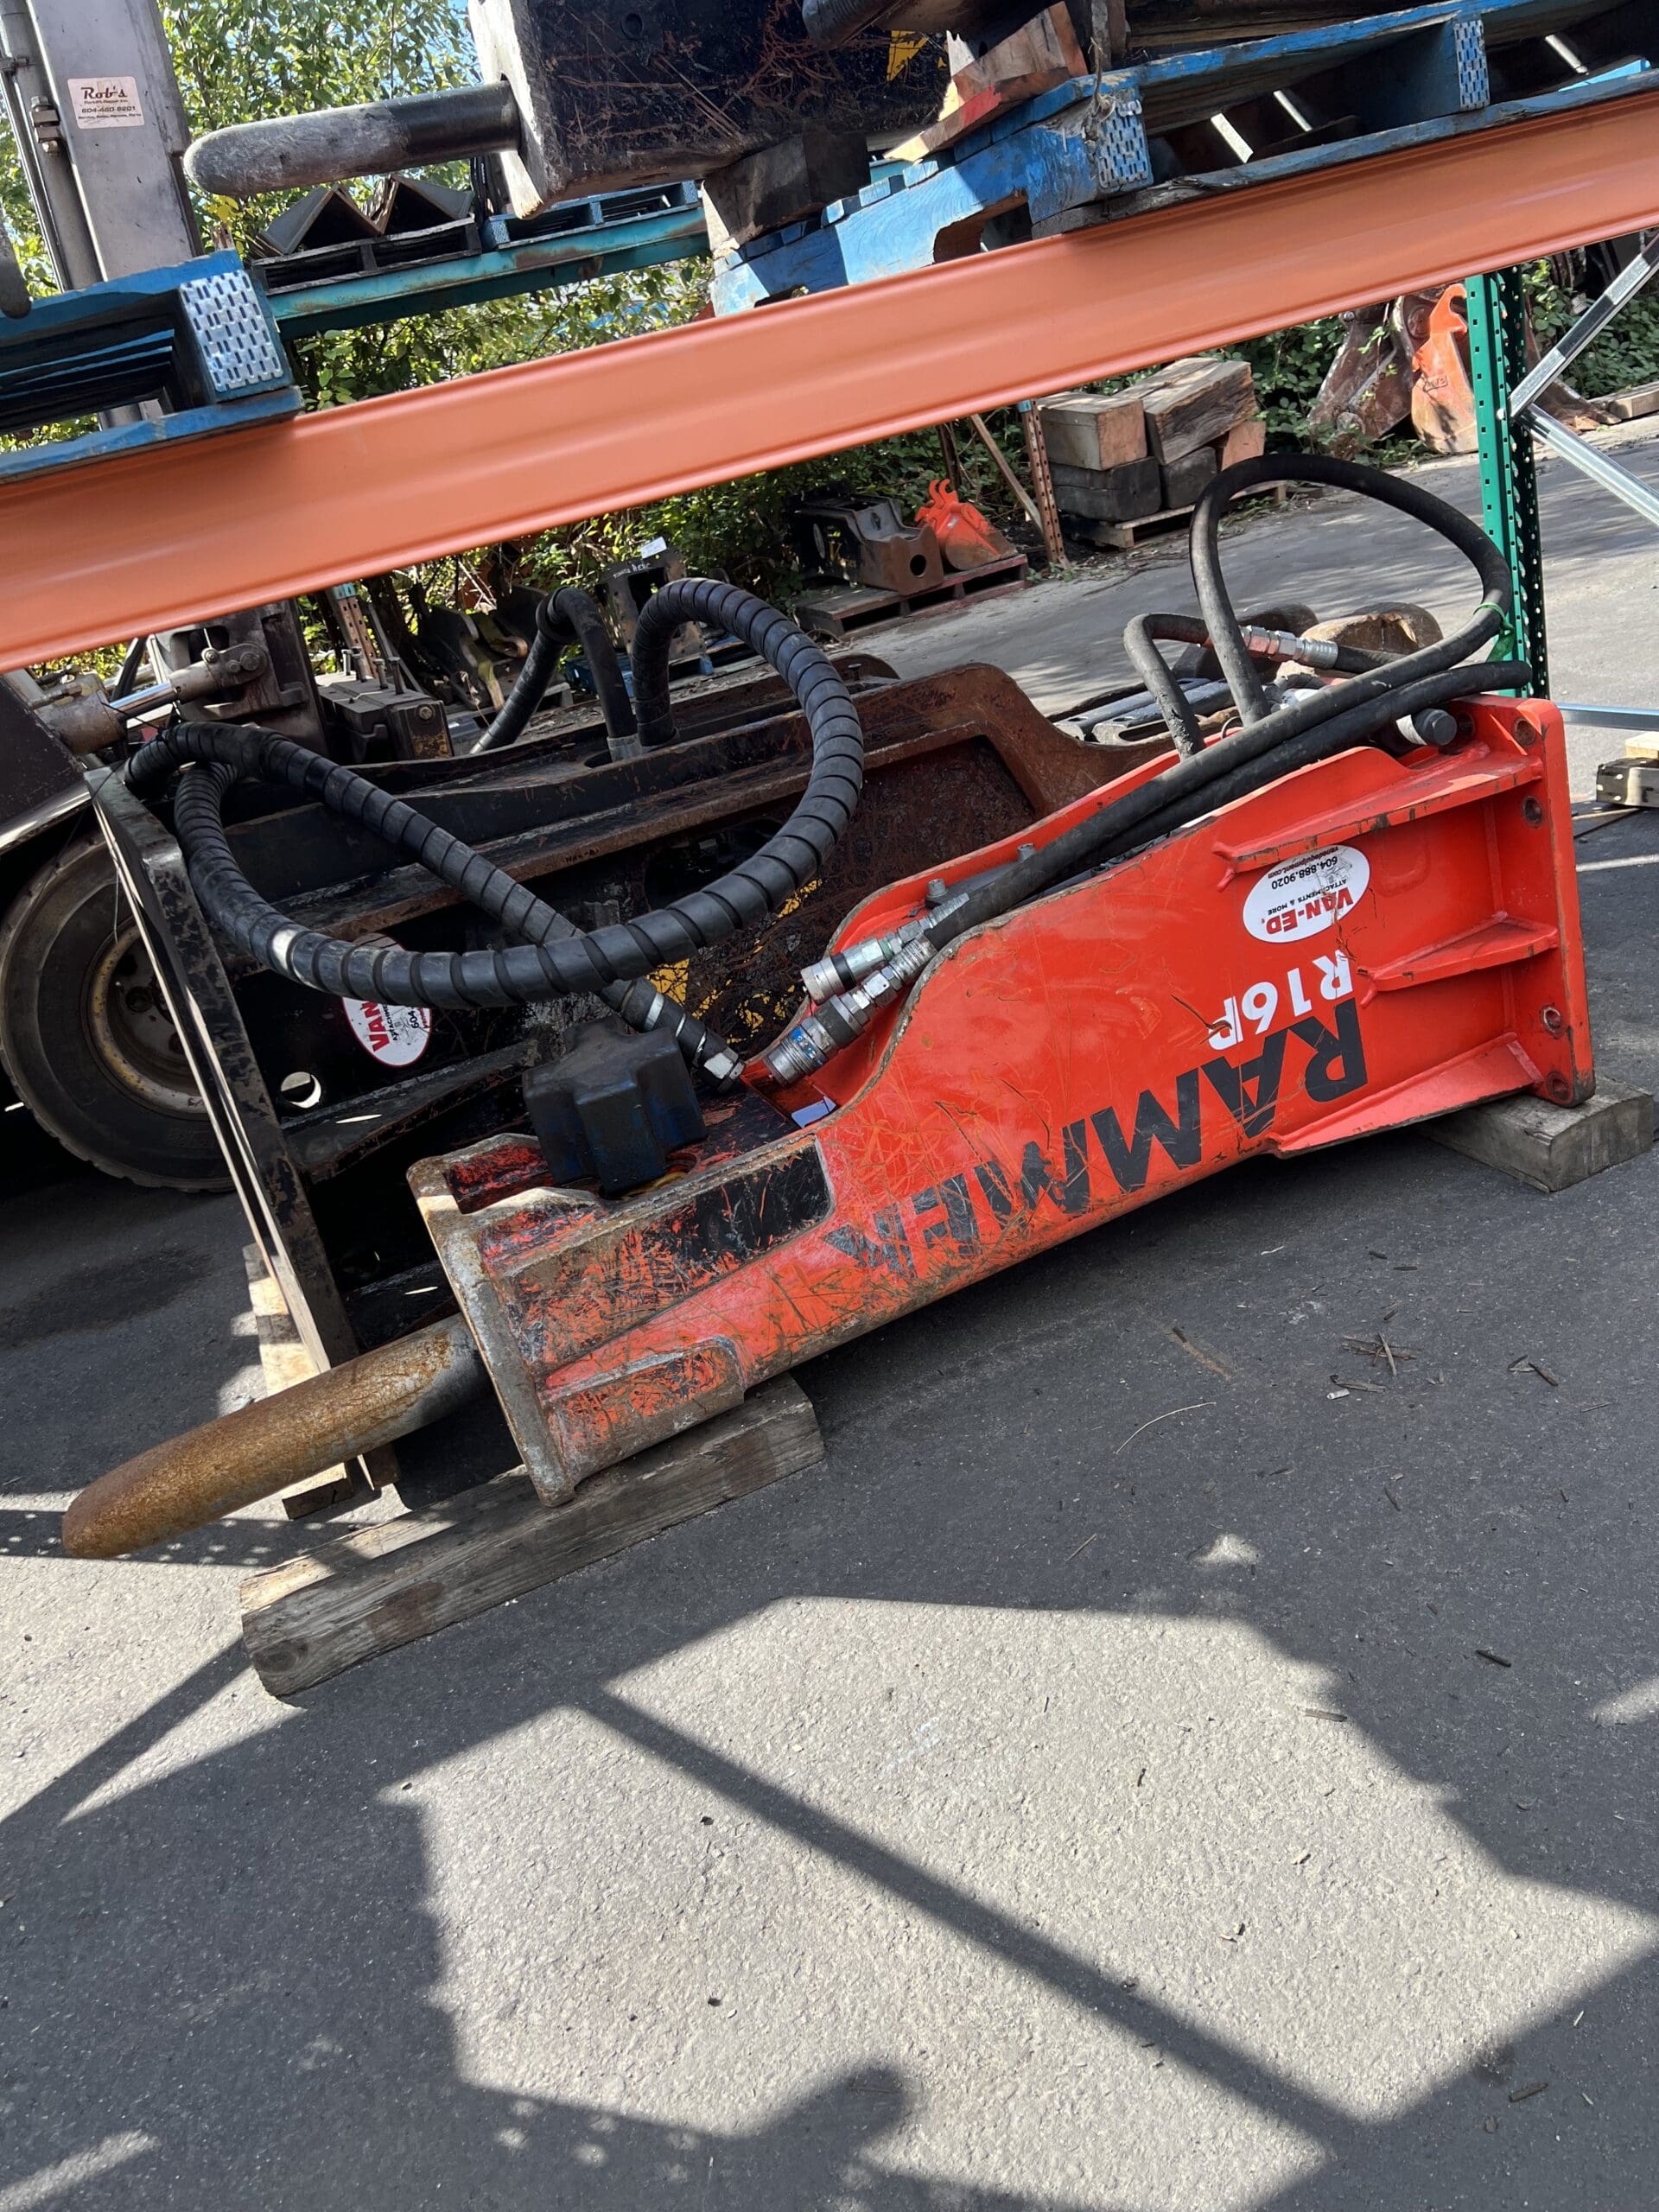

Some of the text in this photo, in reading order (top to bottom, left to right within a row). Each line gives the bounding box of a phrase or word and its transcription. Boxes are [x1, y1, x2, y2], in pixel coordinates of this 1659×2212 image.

[80, 86, 128, 99] Rob's
[1268, 846, 1338, 879] vanedequipment.com
[1271, 855, 1338, 890] 604.888.9020
[1268, 902, 1287, 915] MORE
[1297, 878, 1347, 904] ATTACMENTS
[1209, 950, 1353, 1051] R16P
[361, 1001, 390, 1052] VAN
[381, 1003, 398, 1041] ATTACHME
[823, 997, 1368, 1281] RAMMER
